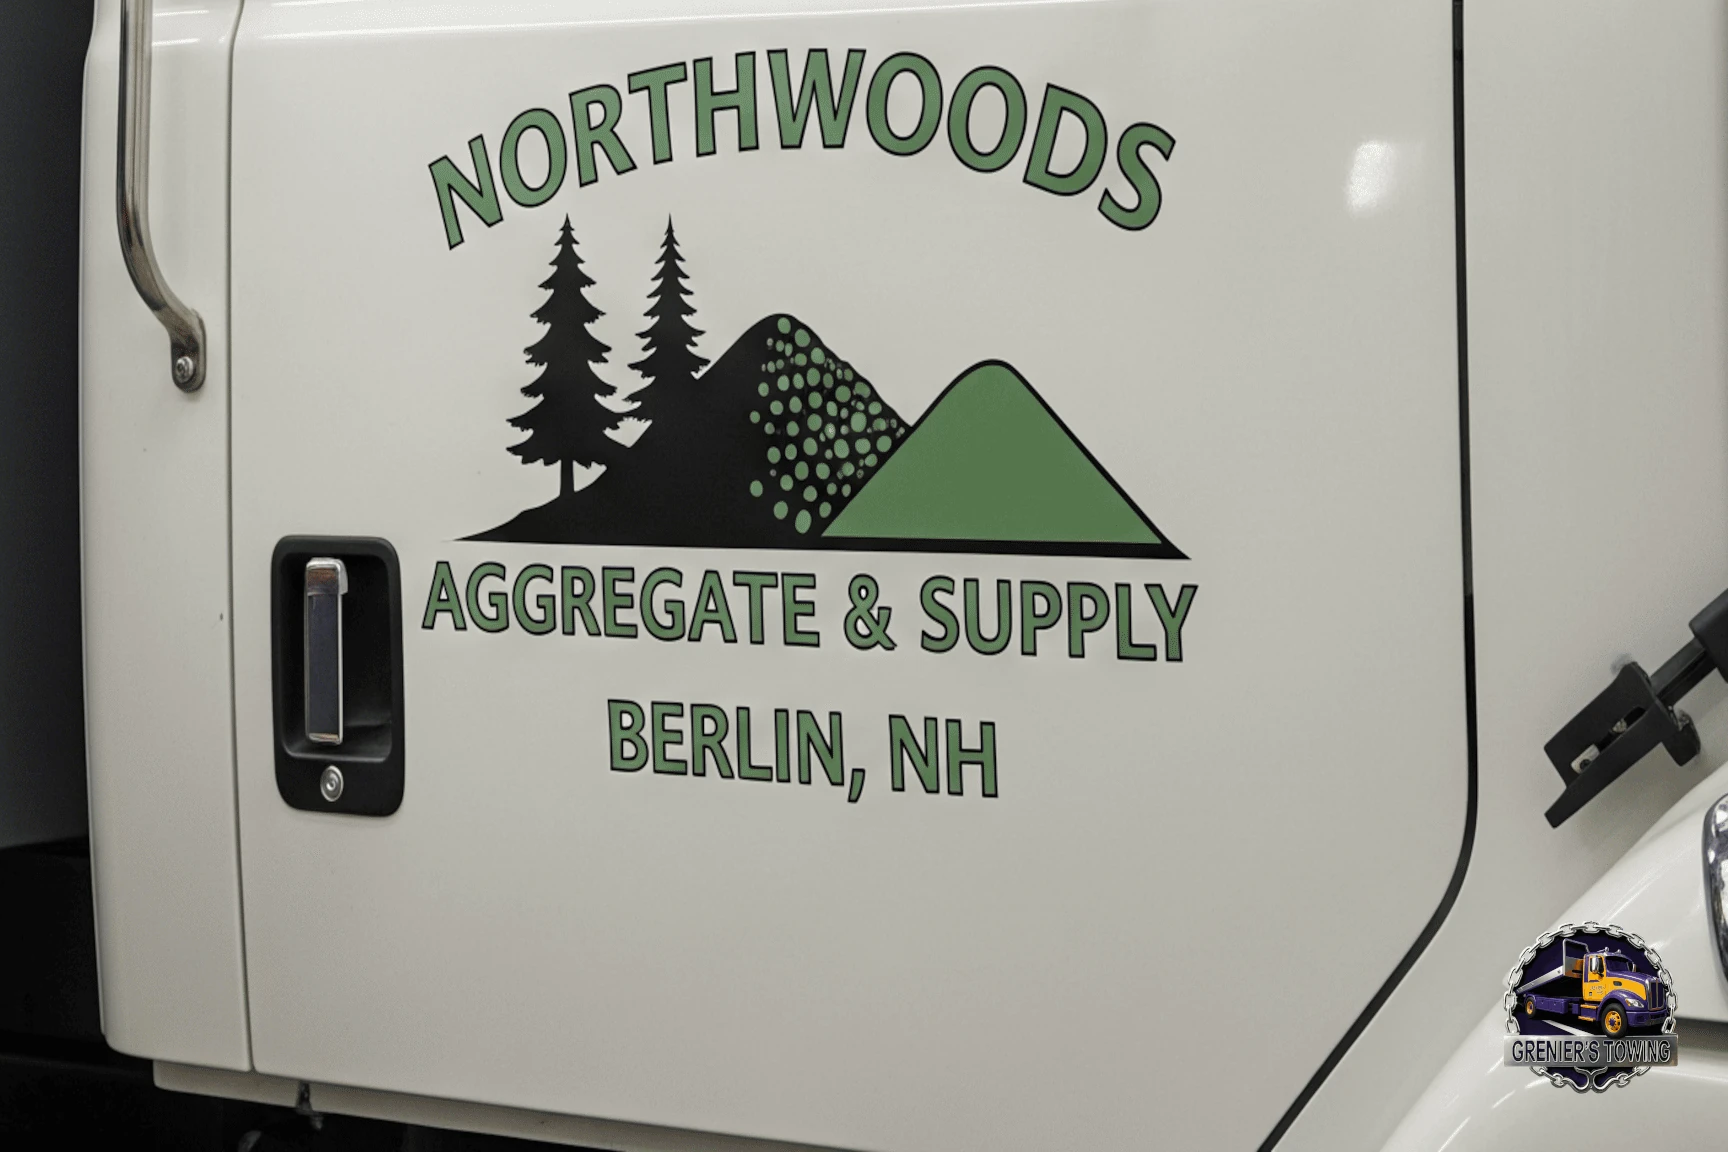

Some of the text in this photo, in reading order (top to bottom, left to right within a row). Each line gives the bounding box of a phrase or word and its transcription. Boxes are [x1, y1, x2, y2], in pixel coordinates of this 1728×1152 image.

[428, 48, 1177, 250] NORTHWOODS
[422, 561, 1198, 663] AGGREGATE & SUPPLY
[607, 698, 999, 804] BERLIN, NH
